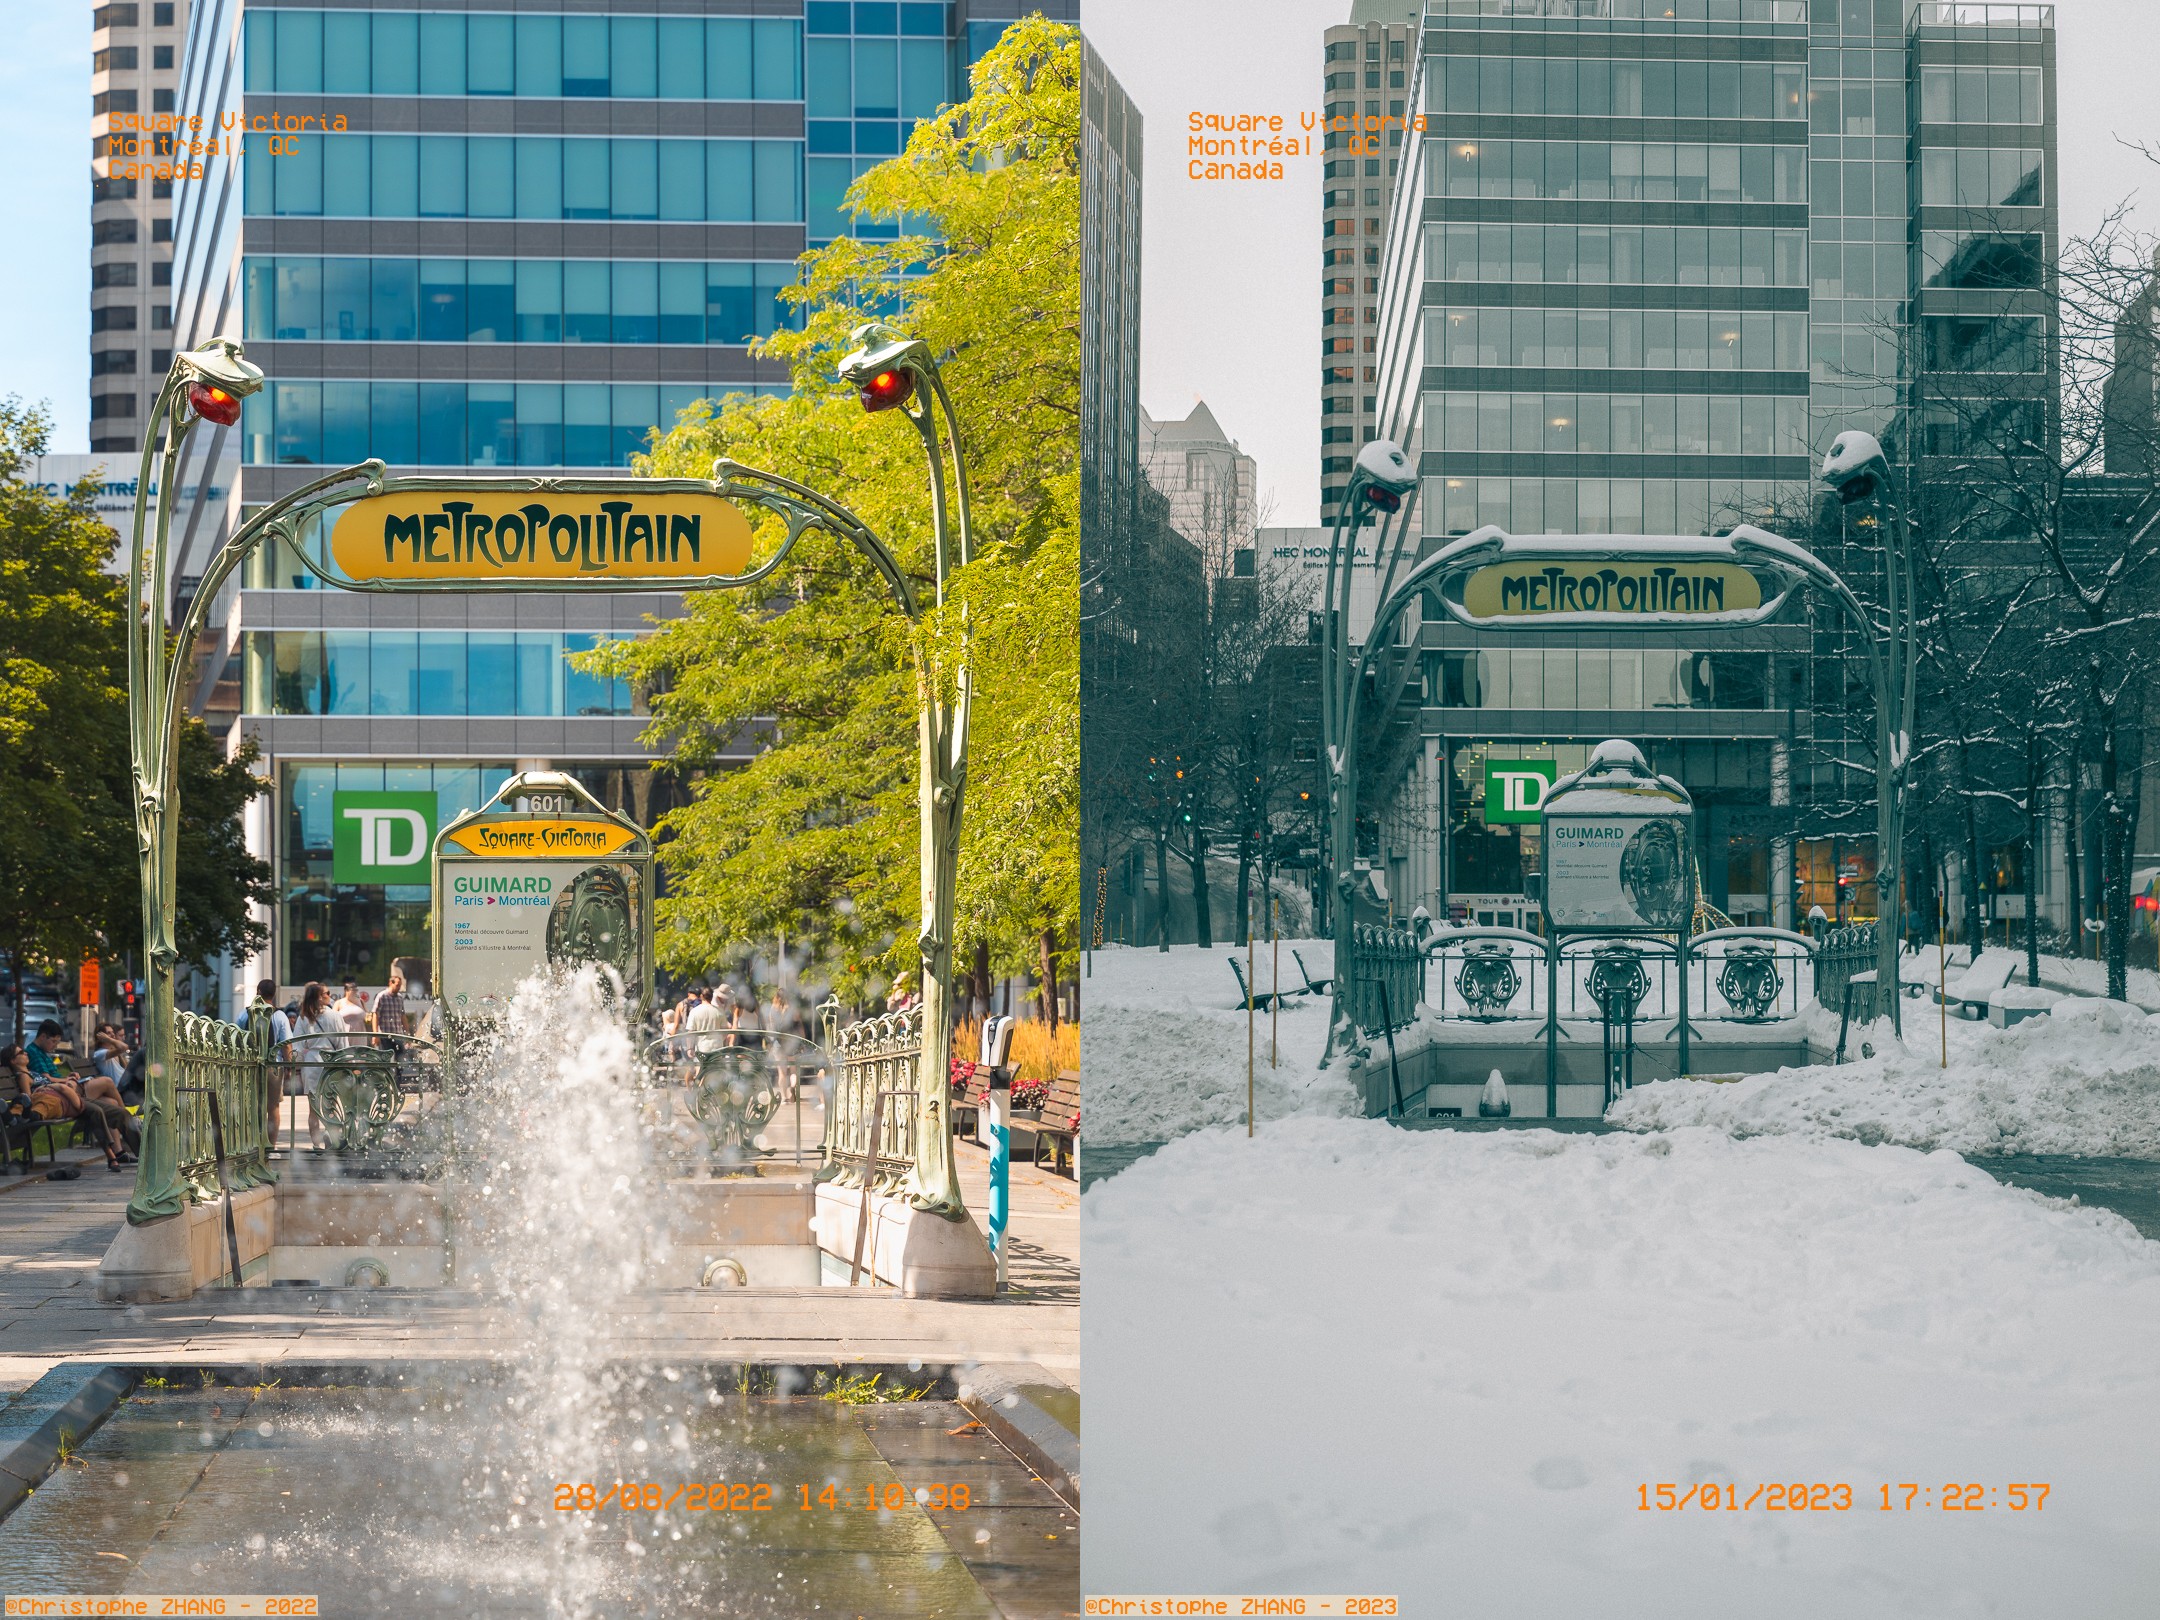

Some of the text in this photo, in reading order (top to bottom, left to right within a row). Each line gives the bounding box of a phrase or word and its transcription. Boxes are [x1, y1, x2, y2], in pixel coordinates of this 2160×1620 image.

[384, 501, 701, 571] METROPOLITAIN
[1273, 547, 1299, 558] HEC
[1502, 567, 1725, 613] METROPOLITAIN
[1492, 772, 1550, 811] TD
[530, 796, 562, 812] 601
[343, 808, 428, 866] TD
[1555, 827, 1625, 839] GUIMARD
[1556, 840, 1623, 848] Paris Montréal
[454, 877, 552, 893] GUIMARD
[454, 895, 551, 906] Paris Montréal
